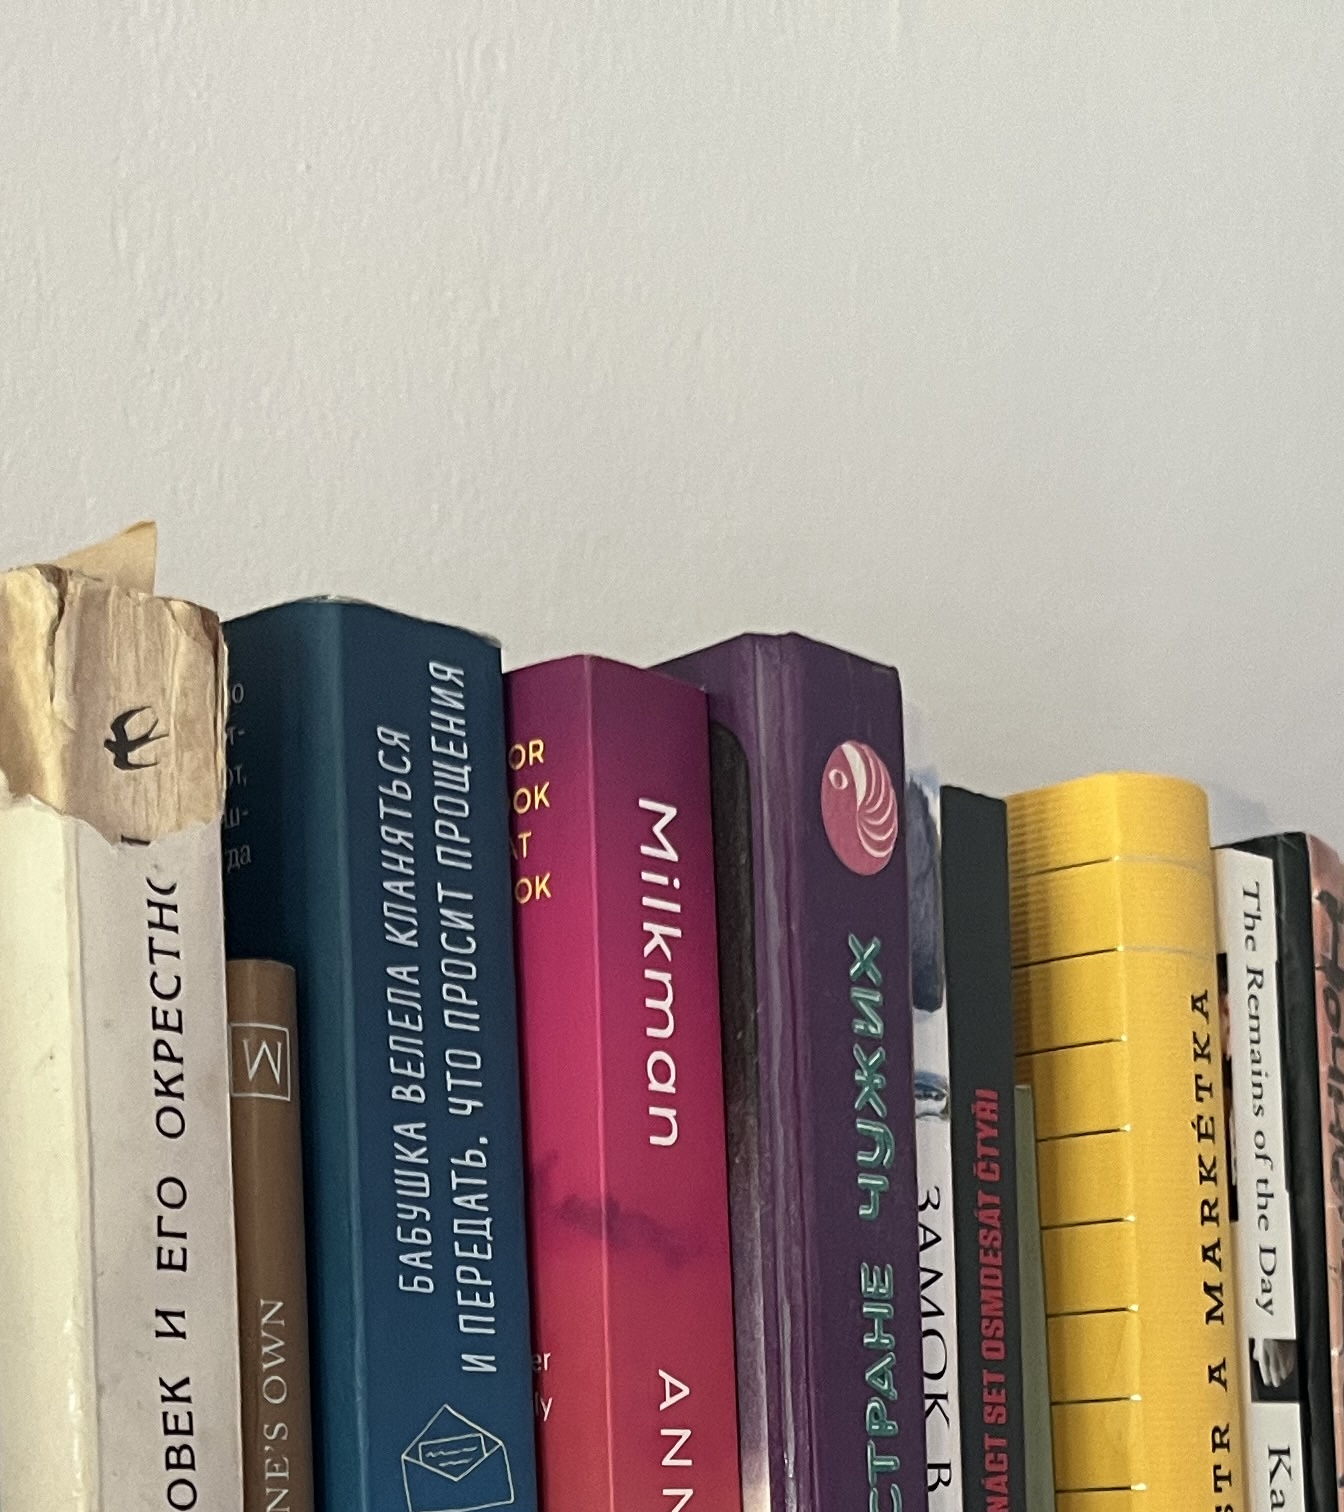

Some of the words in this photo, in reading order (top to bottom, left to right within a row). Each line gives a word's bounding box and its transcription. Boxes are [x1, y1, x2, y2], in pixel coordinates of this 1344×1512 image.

[429, 661, 472, 870] ПРОЩЕНИЯ
[377, 725, 419, 948] КЛАНЯТЬСЯ
[437, 882, 481, 1032] ПРОСИТ
[638, 797, 682, 1146] Milkman
[1241, 880, 1263, 953] The
[386, 965, 426, 1104] ВЕЛЕЛА
[445, 1048, 484, 1116] ЧТО
[848, 933, 896, 1221] ЧУЖИХ
[1246, 963, 1270, 1118] Remains
[393, 1121, 434, 1294] БАБУШКА
[1190, 989, 1226, 1326] MARKÉTKA
[1253, 1131, 1274, 1172] of
[1255, 1176, 1277, 1232] the
[156, 1176, 188, 1272] ЕГО
[451, 1135, 496, 1335] ПЕРЕДАТЬ.
[978, 1193, 1007, 1361] OSMDESÁT
[1254, 1246, 1278, 1317] Day
[155, 1308, 186, 1340] И
[260, 1299, 288, 1405] OWN
[462, 1354, 497, 1373] И
[1208, 1356, 1229, 1392] A
[982, 1369, 1008, 1425] SET
